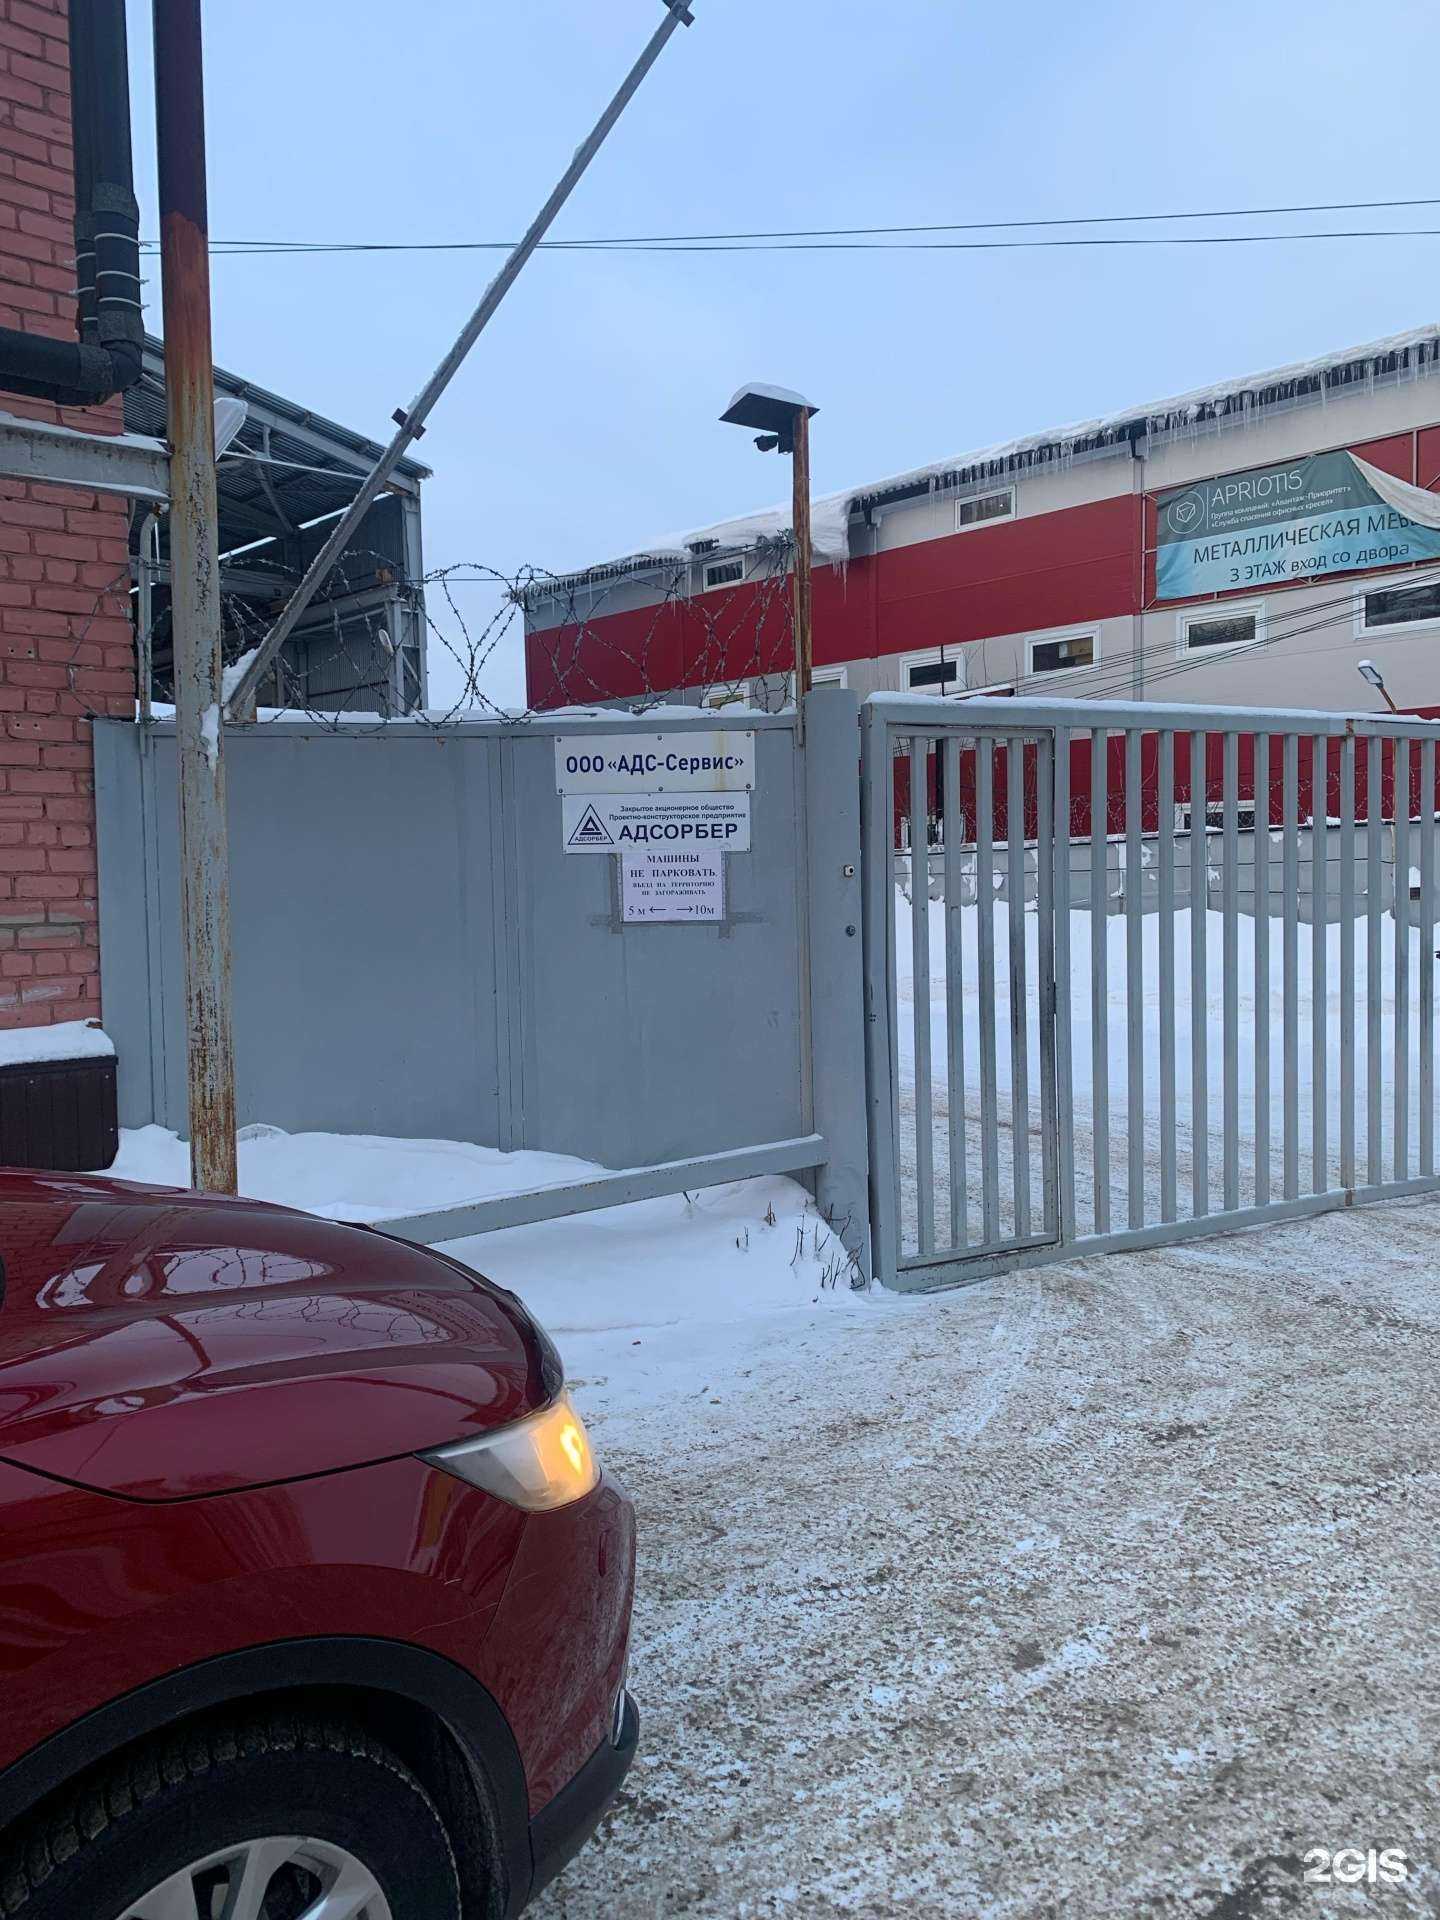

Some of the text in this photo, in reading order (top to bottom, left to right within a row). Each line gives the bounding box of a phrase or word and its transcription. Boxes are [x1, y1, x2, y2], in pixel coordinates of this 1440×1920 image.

[1211, 469, 1303, 506] APRIOTIS
[1210, 510, 1234, 520] Группа
[1193, 518, 1360, 564] МЕТАЛЛИЧЕСКАЯ
[1230, 544, 1409, 583] 3 ЭТАЖ вход со двора
[566, 753, 744, 776] ООО «АДС-Сервис»
[620, 805, 654, 813] Закрытое
[654, 805, 699, 813] акционерное
[609, 811, 747, 821] Проектно-конструкторское предприятие
[618, 823, 738, 843] АДСОРБЕР
[647, 854, 700, 863] МАШИНЫ
[630, 869, 645, 878] НЕ
[655, 889, 706, 897] ЗАГОРАЖИВАТЬ
[628, 905, 634, 916] 5
[695, 904, 714, 915] 10м
